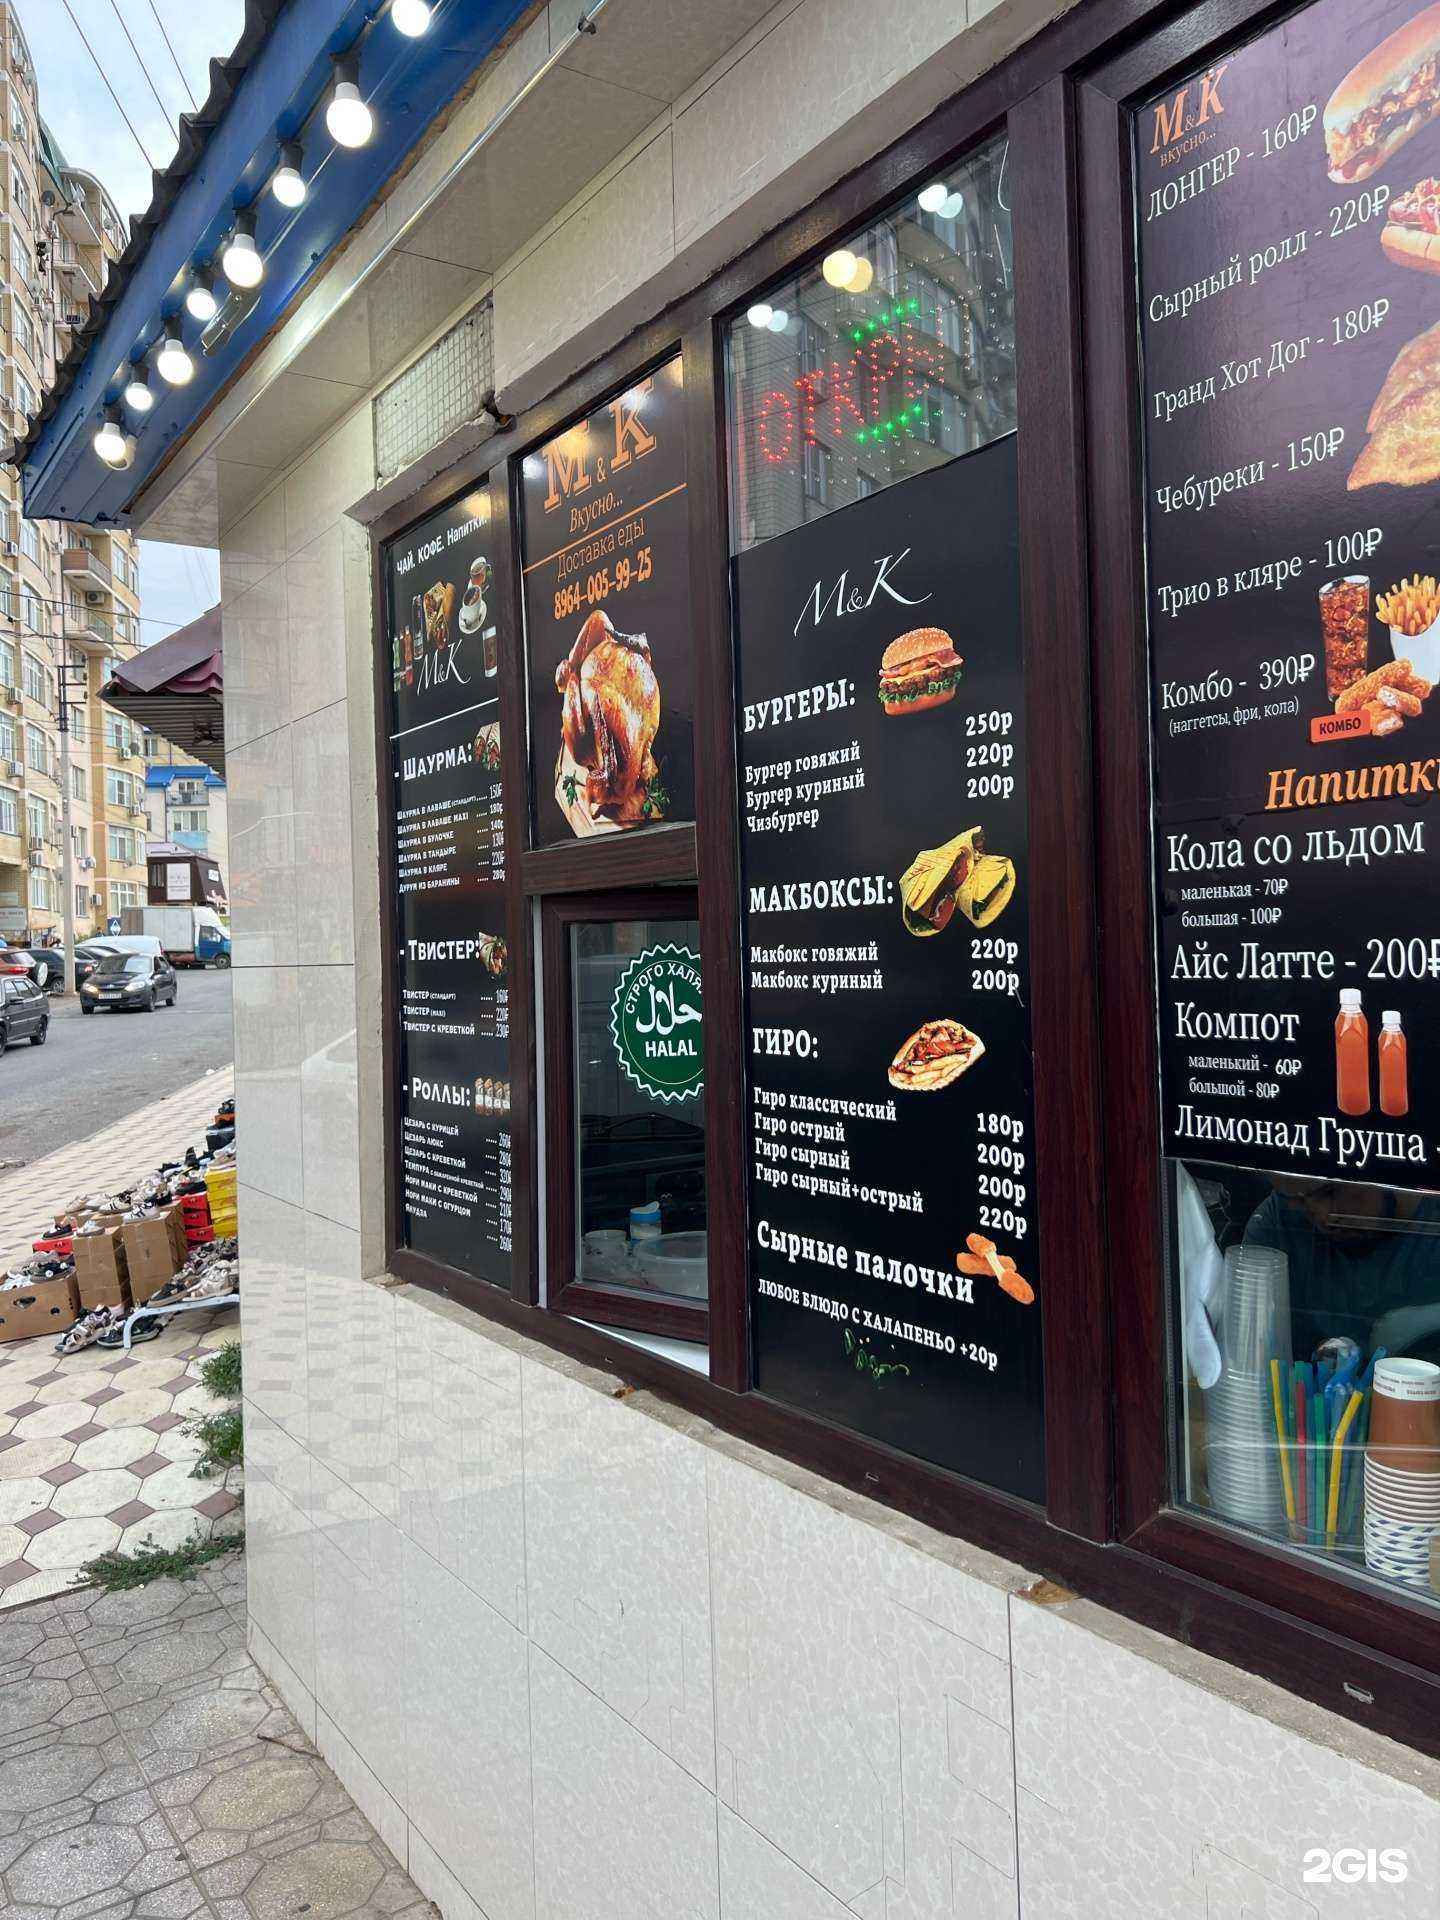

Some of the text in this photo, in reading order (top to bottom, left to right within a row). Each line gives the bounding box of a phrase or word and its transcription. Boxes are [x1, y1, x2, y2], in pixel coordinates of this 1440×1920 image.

[1147, 104, 1318, 222] ЛОНГЕР 160₽
[1149, 185, 1390, 322] Сырный ролл 220₽
[1153, 299, 1390, 423] Гранд Хот Дог 180₽
[1156, 427, 1345, 514] Чебуреки 150₽
[557, 518, 645, 582] Доставка еды
[554, 546, 653, 620] 8964-005-99-25
[1158, 527, 1383, 618] Трио в кляре 100₽
[1161, 653, 1316, 710] Комбо 390₽
[743, 678, 856, 733] БУРГЕРЫ:
[965, 710, 1013, 738] 250р
[1169, 695, 1300, 738] (наггетсы, фри, кола)
[1319, 717, 1362, 736] КОМБО
[403, 742, 472, 781] ШАУРМА:
[745, 740, 861, 786] Бургер говяжий
[966, 742, 1014, 769] 220р
[746, 768, 865, 812] Бургер куриный
[966, 774, 1015, 800] 200р
[1264, 757, 1440, 811] Напитк
[747, 807, 820, 833] Чизбургер
[1167, 821, 1426, 873] Кола со льдом
[750, 875, 894, 913] МАКБОКСЫ:
[1181, 879, 1288, 901] маленькая 70₽
[1181, 907, 1282, 928] большая 100₽
[750, 941, 879, 963] Макбокс говяжий
[971, 938, 1019, 965] 220р
[1171, 941, 1229, 980] Айс
[1237, 942, 1335, 980] Латте
[625, 963, 702, 1014] СТРОГО ХАЛЯ
[751, 969, 884, 994] Макбокс куриный
[972, 969, 1020, 996] 200р
[1174, 1001, 1300, 1041] Компот
[646, 1039, 697, 1058] HALAL
[752, 1027, 818, 1059] ГИРО:
[1188, 1054, 1302, 1077] маленький 60₽
[754, 1086, 897, 1122] Гиро классический
[1189, 1078, 1280, 1099] большой 80₽
[754, 1112, 845, 1144] Гиро острый
[976, 1112, 1024, 1143] 180р
[1174, 1104, 1427, 1168] Лимонад Груша
[755, 1137, 850, 1170] Гиро сырный
[977, 1143, 1025, 1175] 200р
[755, 1163, 923, 1213] Гиро сырный+острый
[978, 1174, 1026, 1206] 200р
[979, 1205, 1027, 1240] 220р
[757, 1221, 974, 1304] Сырные палочки
[758, 1278, 800, 1304] ЛЮБОЕ
[802, 1291, 848, 1322] БЛЮДО
[851, 1304, 860, 1324] С
[863, 1311, 955, 1354] ХАЛАПЕНЬО
